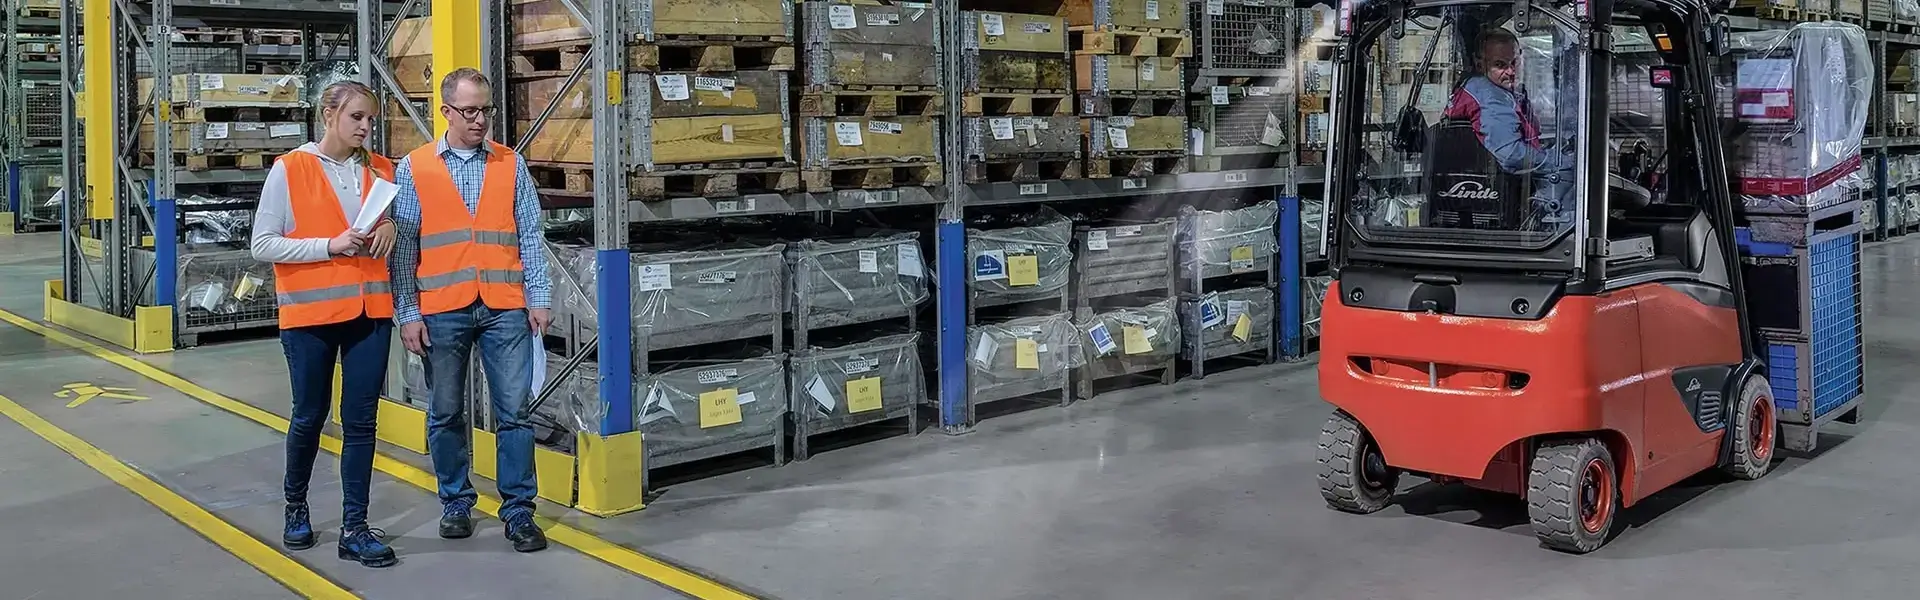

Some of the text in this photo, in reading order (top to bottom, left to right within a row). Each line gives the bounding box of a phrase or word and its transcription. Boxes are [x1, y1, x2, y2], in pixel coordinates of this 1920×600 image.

[160, 25, 167, 34] B
[1437, 181, 1499, 200] Linde
[1685, 378, 1701, 393] Linde
[714, 397, 728, 407] LHY
